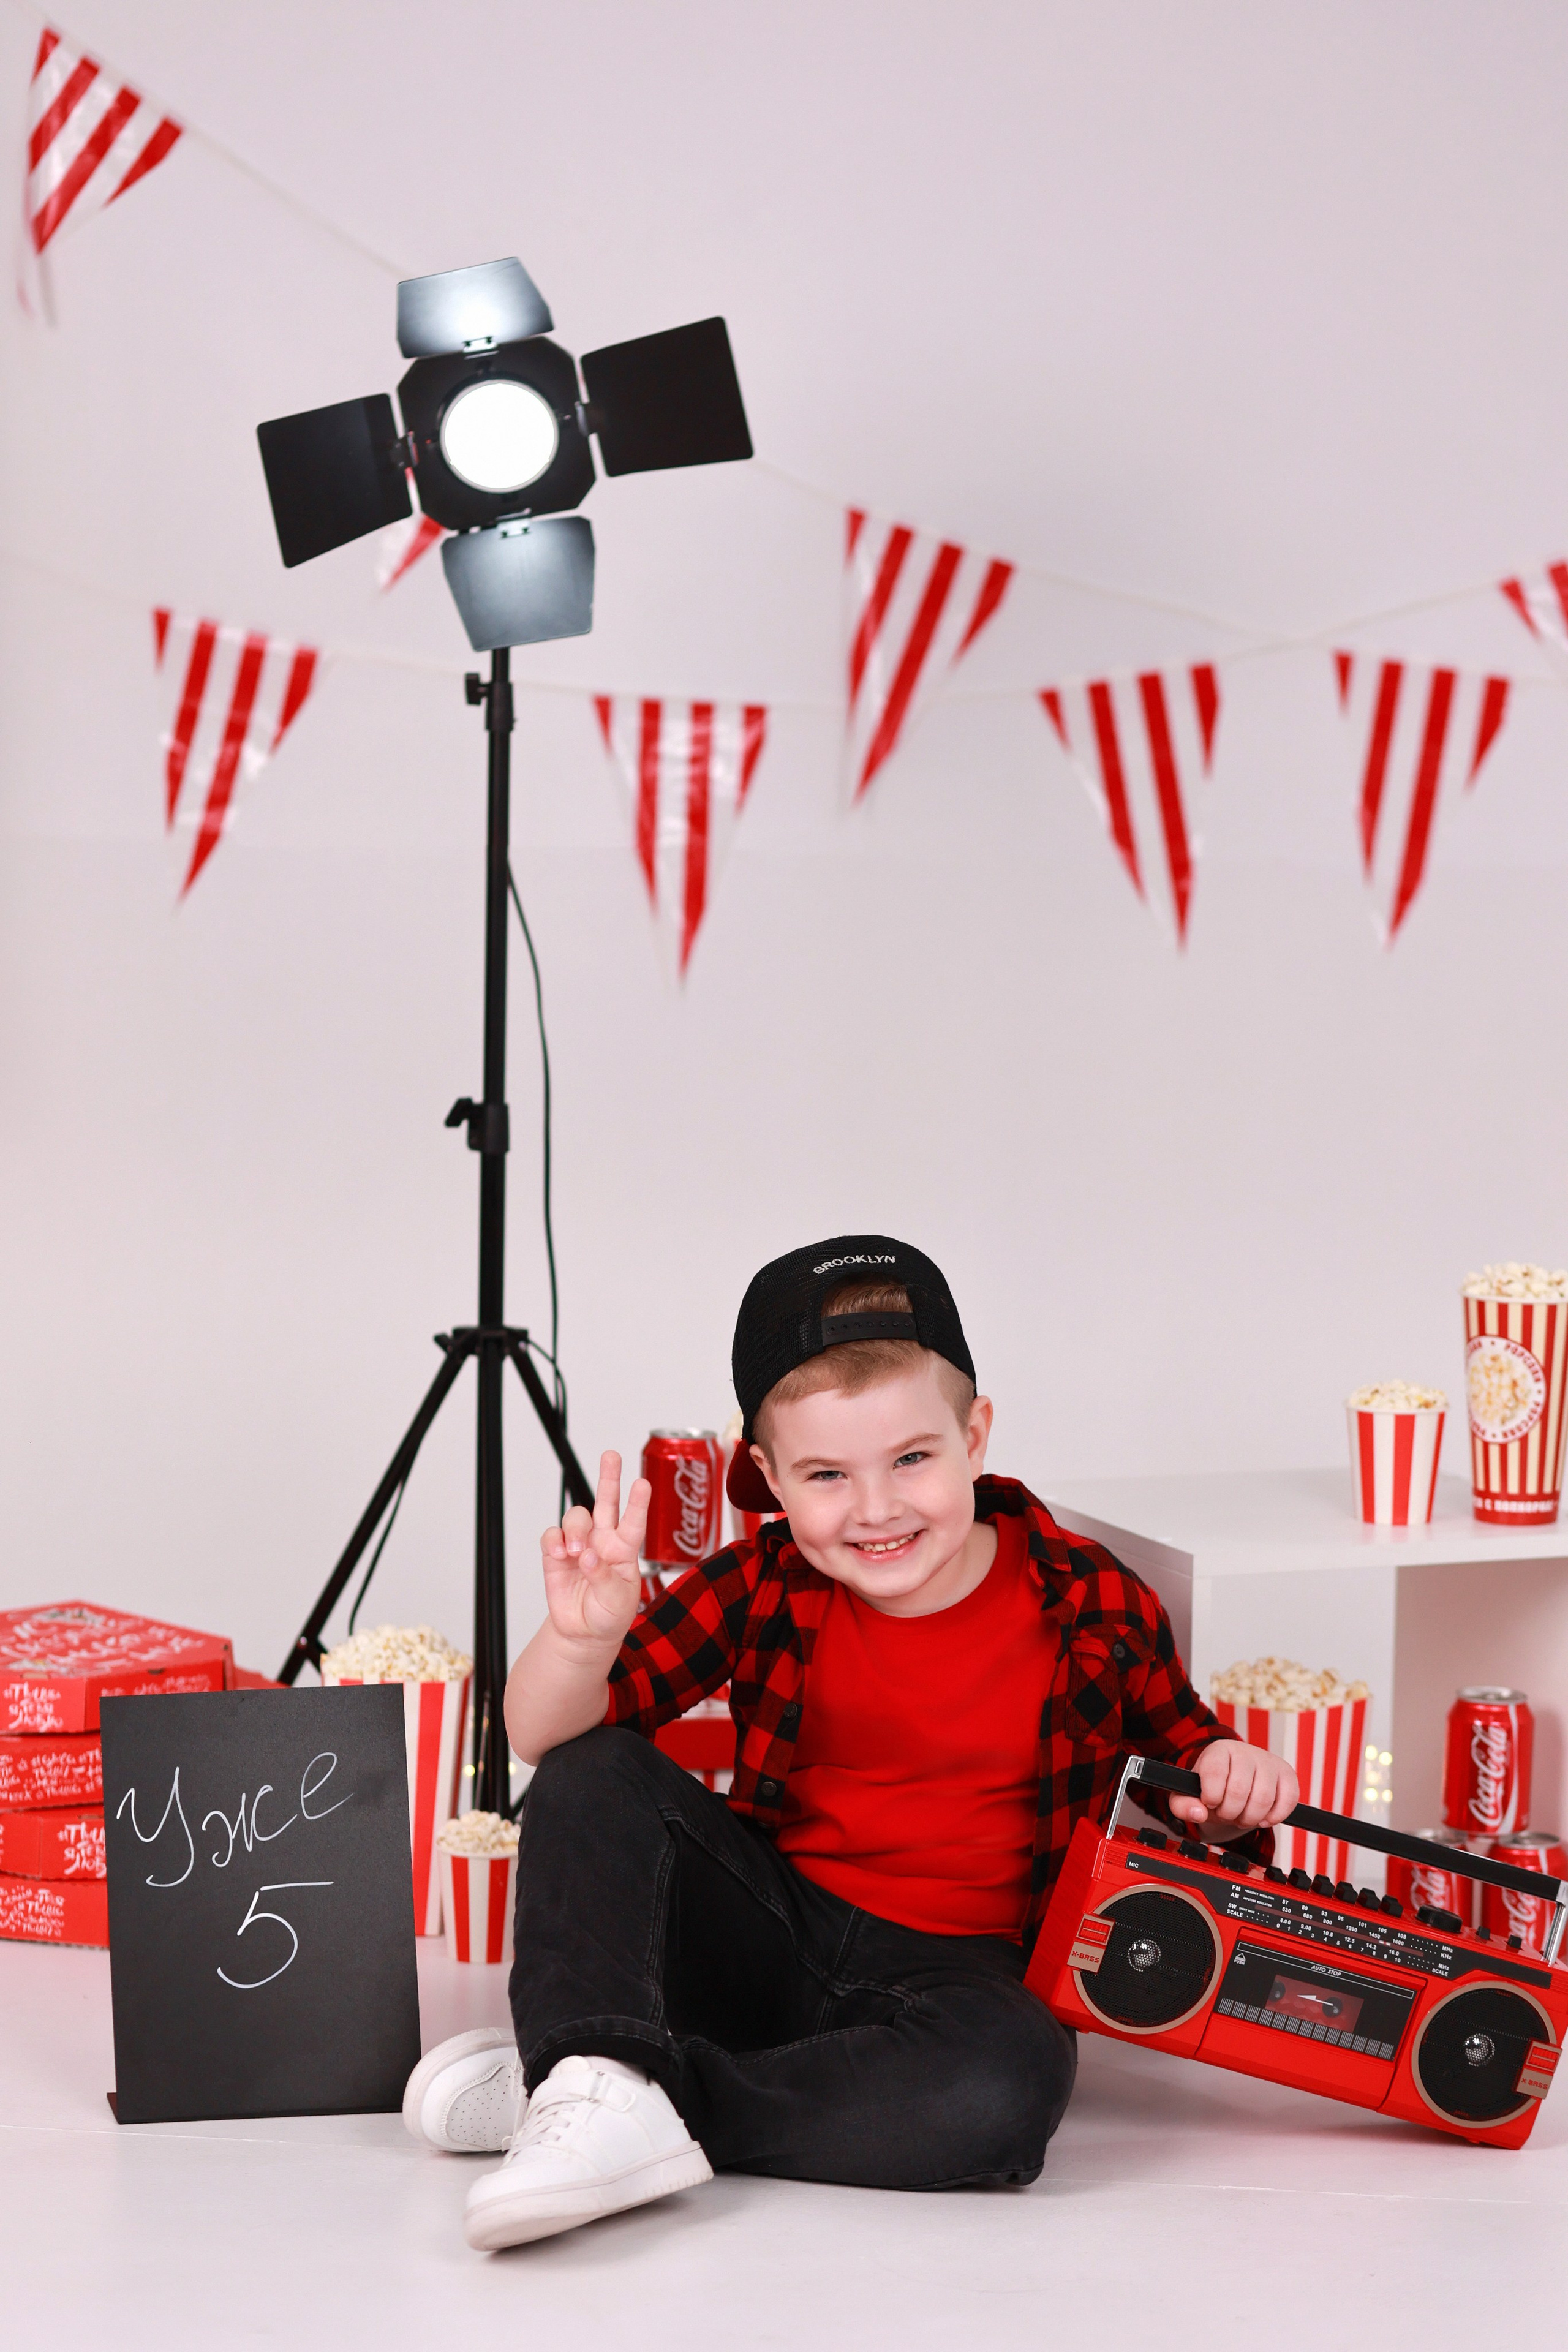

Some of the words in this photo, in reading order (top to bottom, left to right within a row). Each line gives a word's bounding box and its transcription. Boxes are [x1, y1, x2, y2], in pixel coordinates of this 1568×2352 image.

[813, 1254, 895, 1274] BROOKLYN
[116, 1752, 356, 1888] Уже
[216, 1880, 334, 1989] 5
[1226, 1909, 1244, 1918] SCALE
[1431, 1967, 1449, 1977] SCALE
[1368, 1931, 1381, 1940] 1450
[1440, 1952, 1452, 1961] KHz
[1389, 1948, 1400, 1957] 16.0
[1438, 1962, 1450, 1972] MHz
[1441, 1945, 1453, 1954] MHz
[1311, 1964, 1327, 1973] AUTO
[1327, 1969, 1342, 1977] STOP
